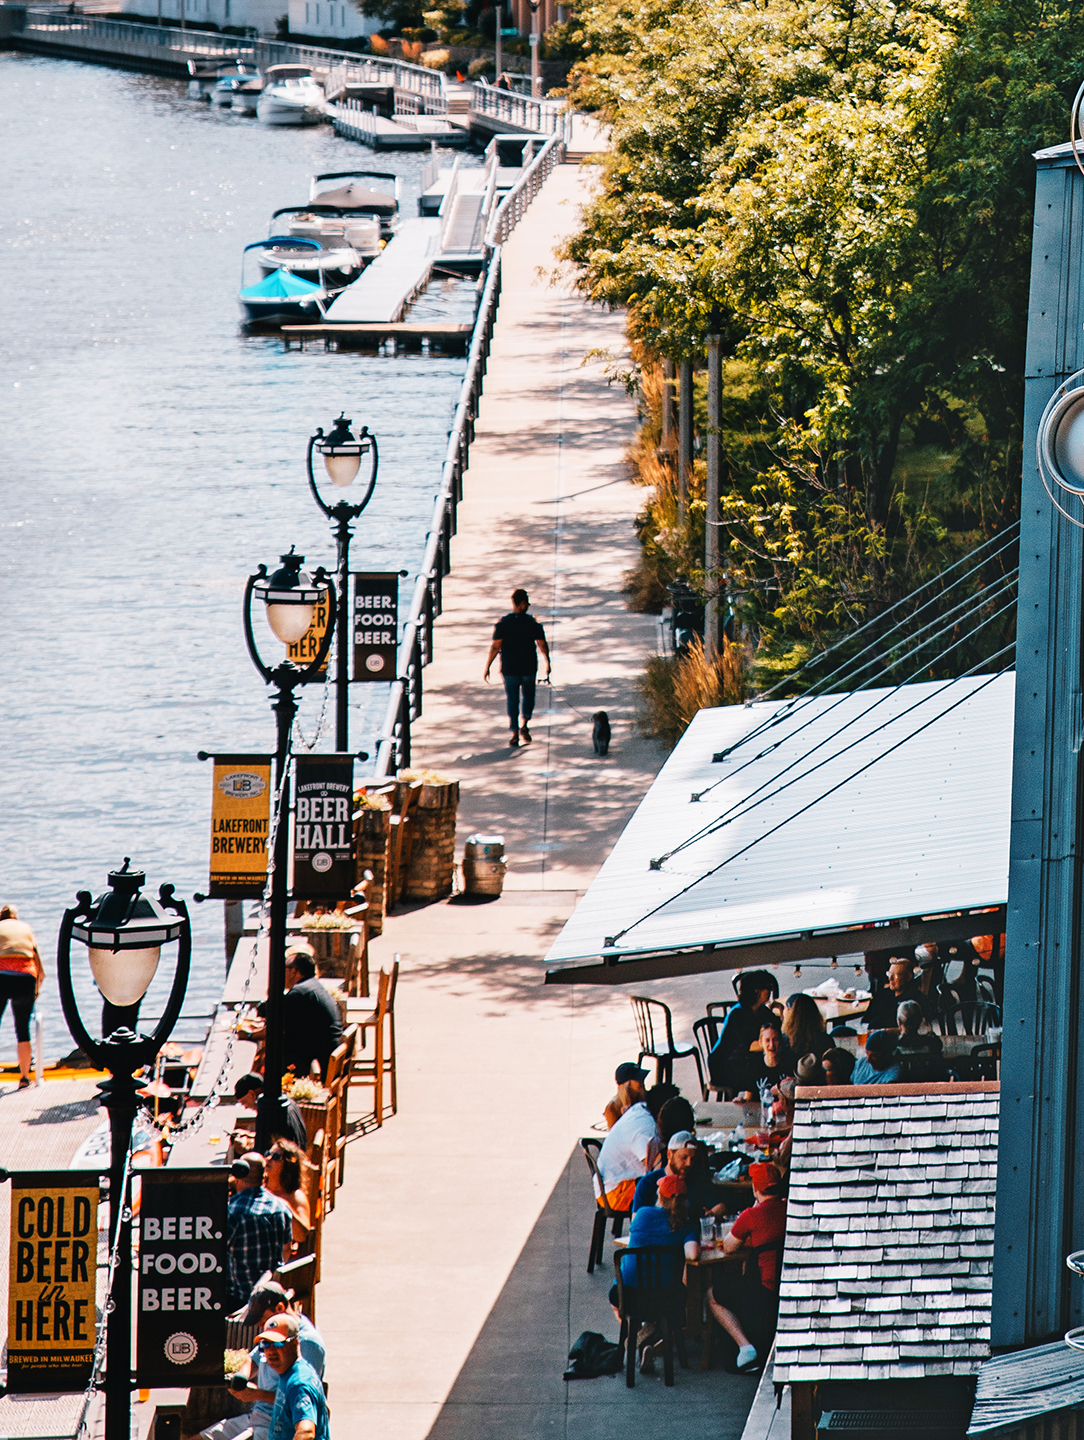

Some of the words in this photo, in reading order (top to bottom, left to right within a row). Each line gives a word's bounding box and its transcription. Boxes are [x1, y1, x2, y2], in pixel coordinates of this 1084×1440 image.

[355, 595, 396, 609] BEER.
[355, 613, 396, 626] FOOD.
[289, 637, 324, 657] HER
[355, 631, 396, 645] BEER.
[298, 782, 326, 793] LAKEFRONT
[326, 782, 350, 793] BREWERY
[296, 797, 349, 822] BEER
[213, 818, 269, 833] LAKEFRONT
[295, 824, 350, 849] HALL
[212, 837, 268, 854] BREWERY
[18, 1196, 91, 1239] COLD
[144, 1216, 223, 1241] BEER.
[16, 1240, 89, 1283] BEER
[142, 1252, 223, 1275] FOOD.
[38, 1279, 66, 1302] in
[142, 1287, 222, 1312] BEER.
[15, 1299, 89, 1341] HERE
[9, 1355, 39, 1364] BREWED
[50, 1353, 93, 1363] MILWAUKEE
